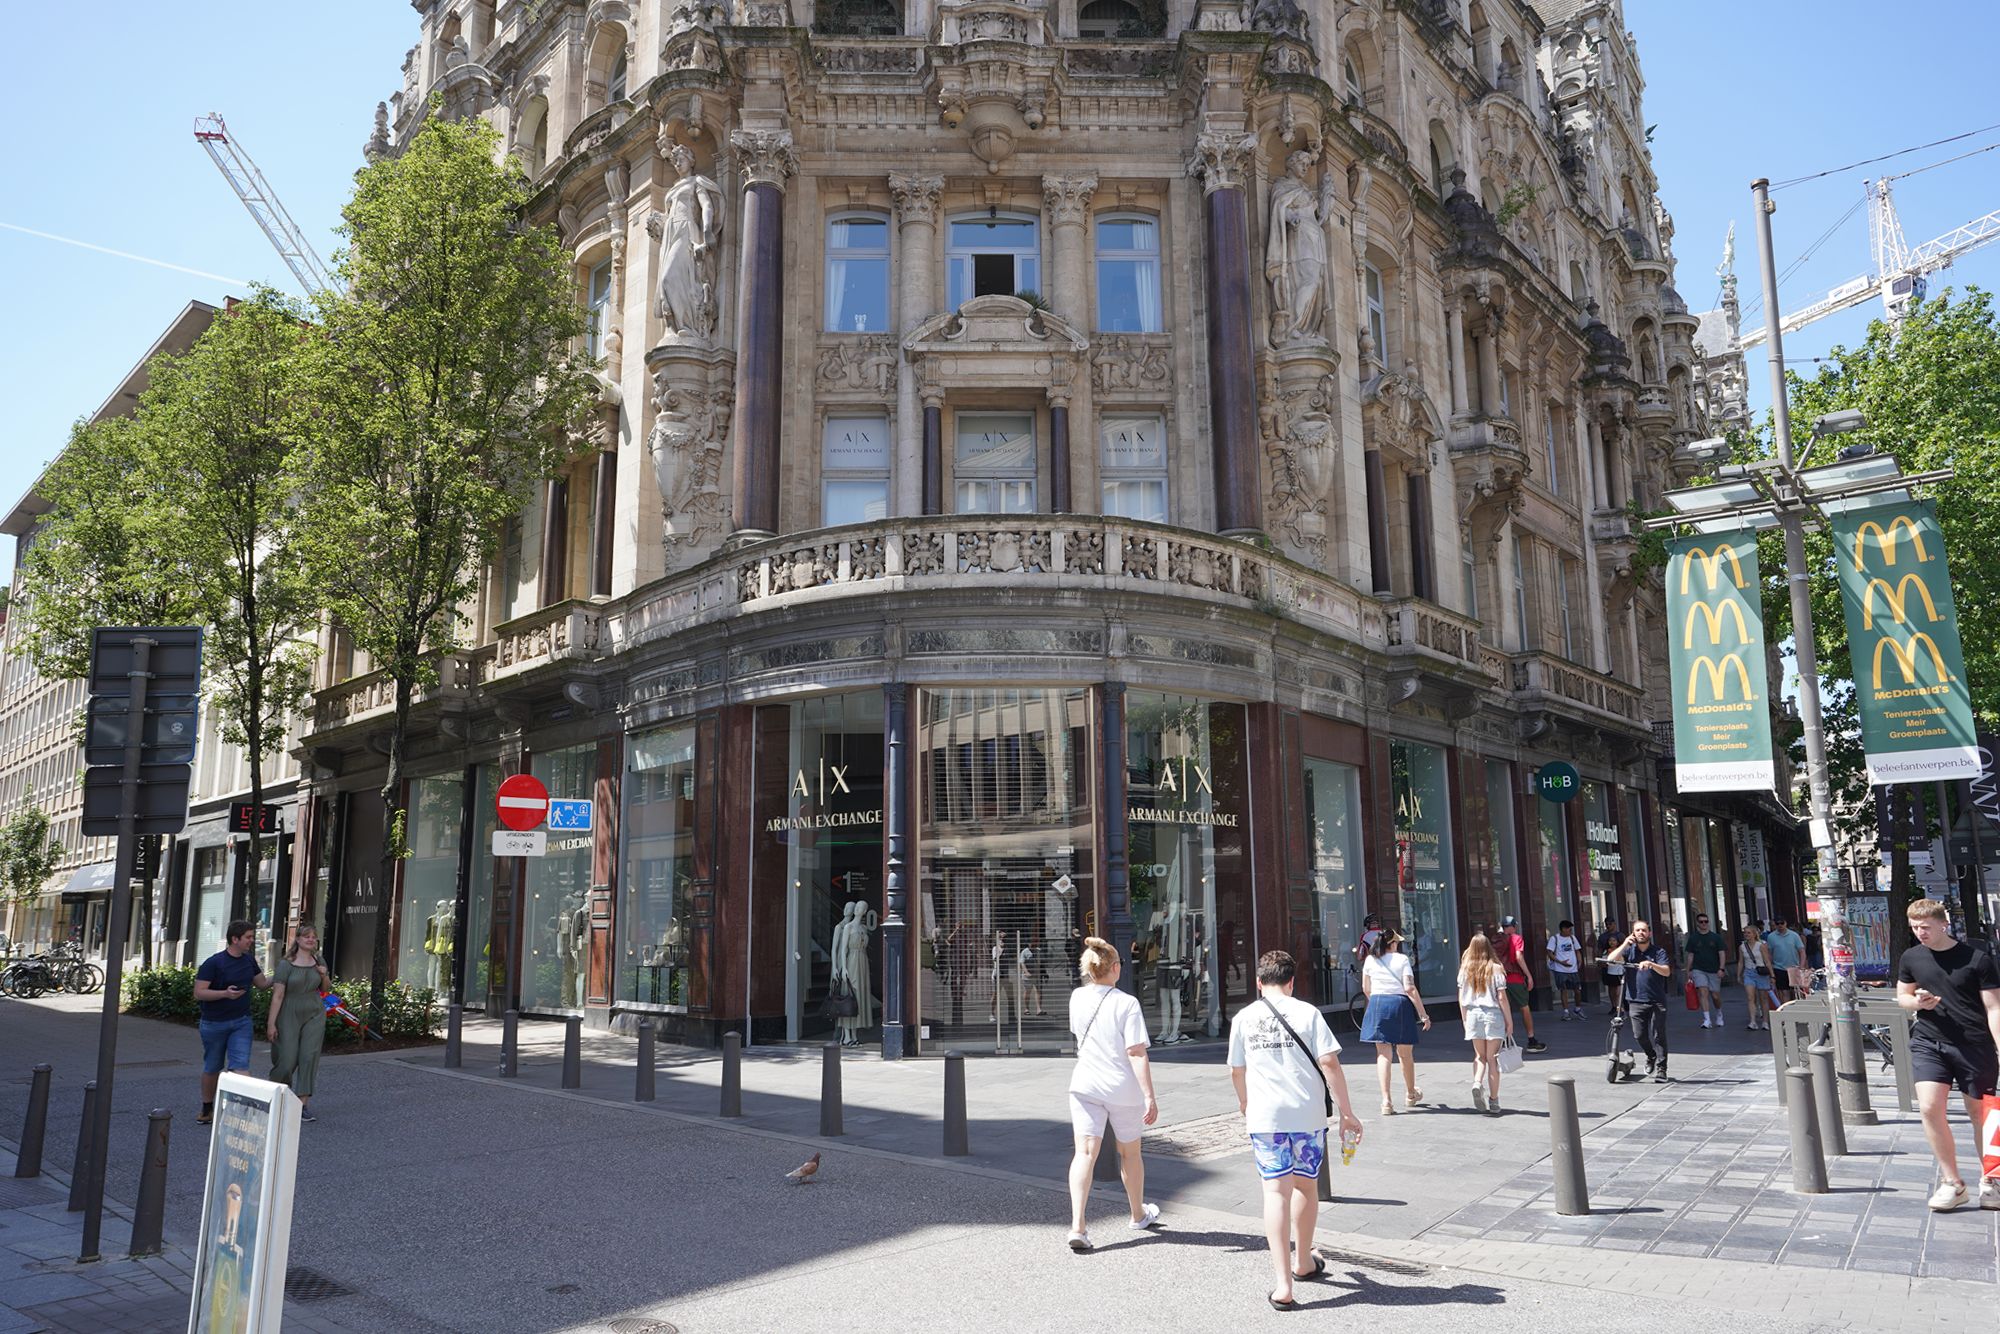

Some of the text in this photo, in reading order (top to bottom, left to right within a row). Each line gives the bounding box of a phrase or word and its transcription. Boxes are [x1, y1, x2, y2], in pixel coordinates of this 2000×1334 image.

[1874, 685, 1950, 700] McDonald's
[1688, 703, 1753, 715] McDonald's
[1883, 706, 1947, 719] Teniersplaats
[1695, 723, 1749, 733] Teniersplaats
[1906, 719, 1927, 728] Meir
[1712, 733, 1731, 741] Meir
[1889, 728, 1947, 740] Groenplaats
[1697, 742, 1748, 751] Groenplaats
[1873, 758, 1975, 773] beleefantwerpen.be
[1681, 770, 1769, 782] beleefantwerpen.be
[765, 809, 883, 832] ARMANI EXCHANGE
[1128, 808, 1239, 827] ARMANI EXCHANGE
[1410, 831, 1439, 845] EXCHANGE
[1585, 820, 1618, 844] Holland
[1736, 826, 1748, 866] veritas
[1749, 832, 1761, 870] veritas
